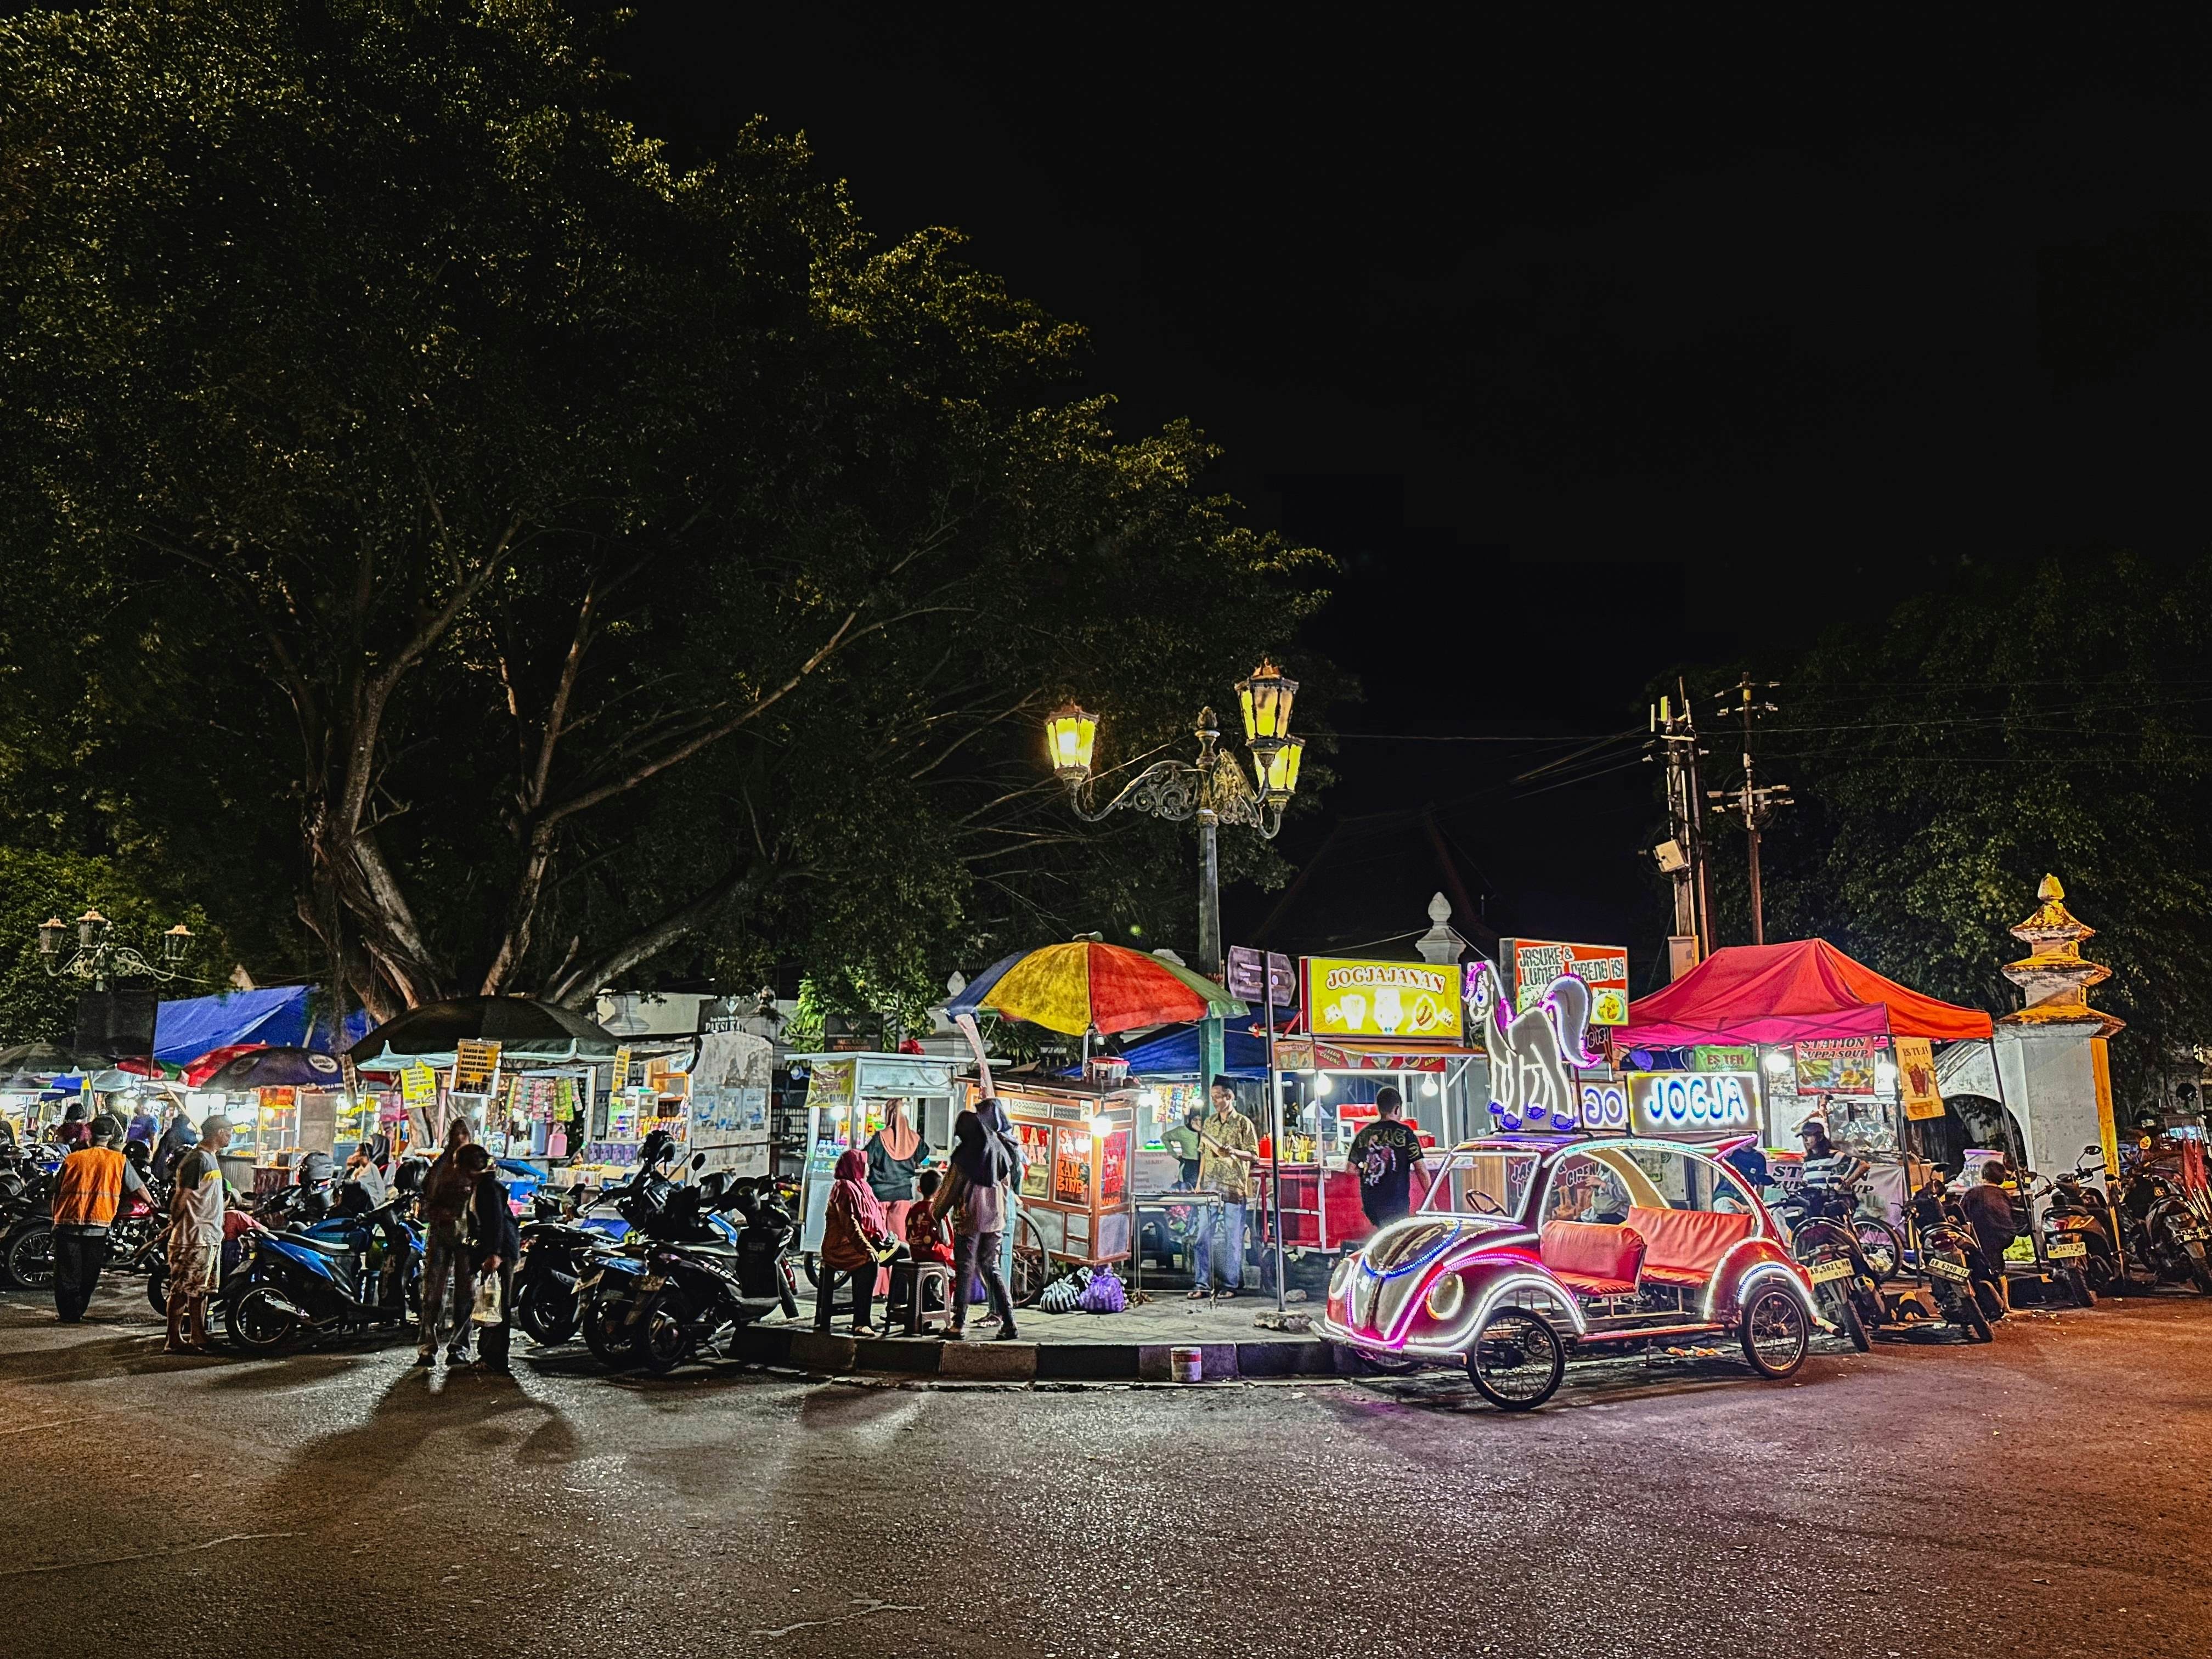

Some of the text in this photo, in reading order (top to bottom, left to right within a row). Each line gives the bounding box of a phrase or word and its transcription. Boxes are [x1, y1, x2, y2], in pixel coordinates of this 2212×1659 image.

[1565, 948, 1573, 959] &
[1327, 967, 1445, 992] JOGJAJANAN
[1801, 1037, 1866, 1049] STATION
[1837, 1049, 1869, 1058] SOUP
[1707, 1054, 1745, 1065] ES TEH
[1648, 1079, 1746, 1122] JOGJA
[1821, 1263, 1840, 1272] 5821
[1941, 1263, 1957, 1272] 6390
